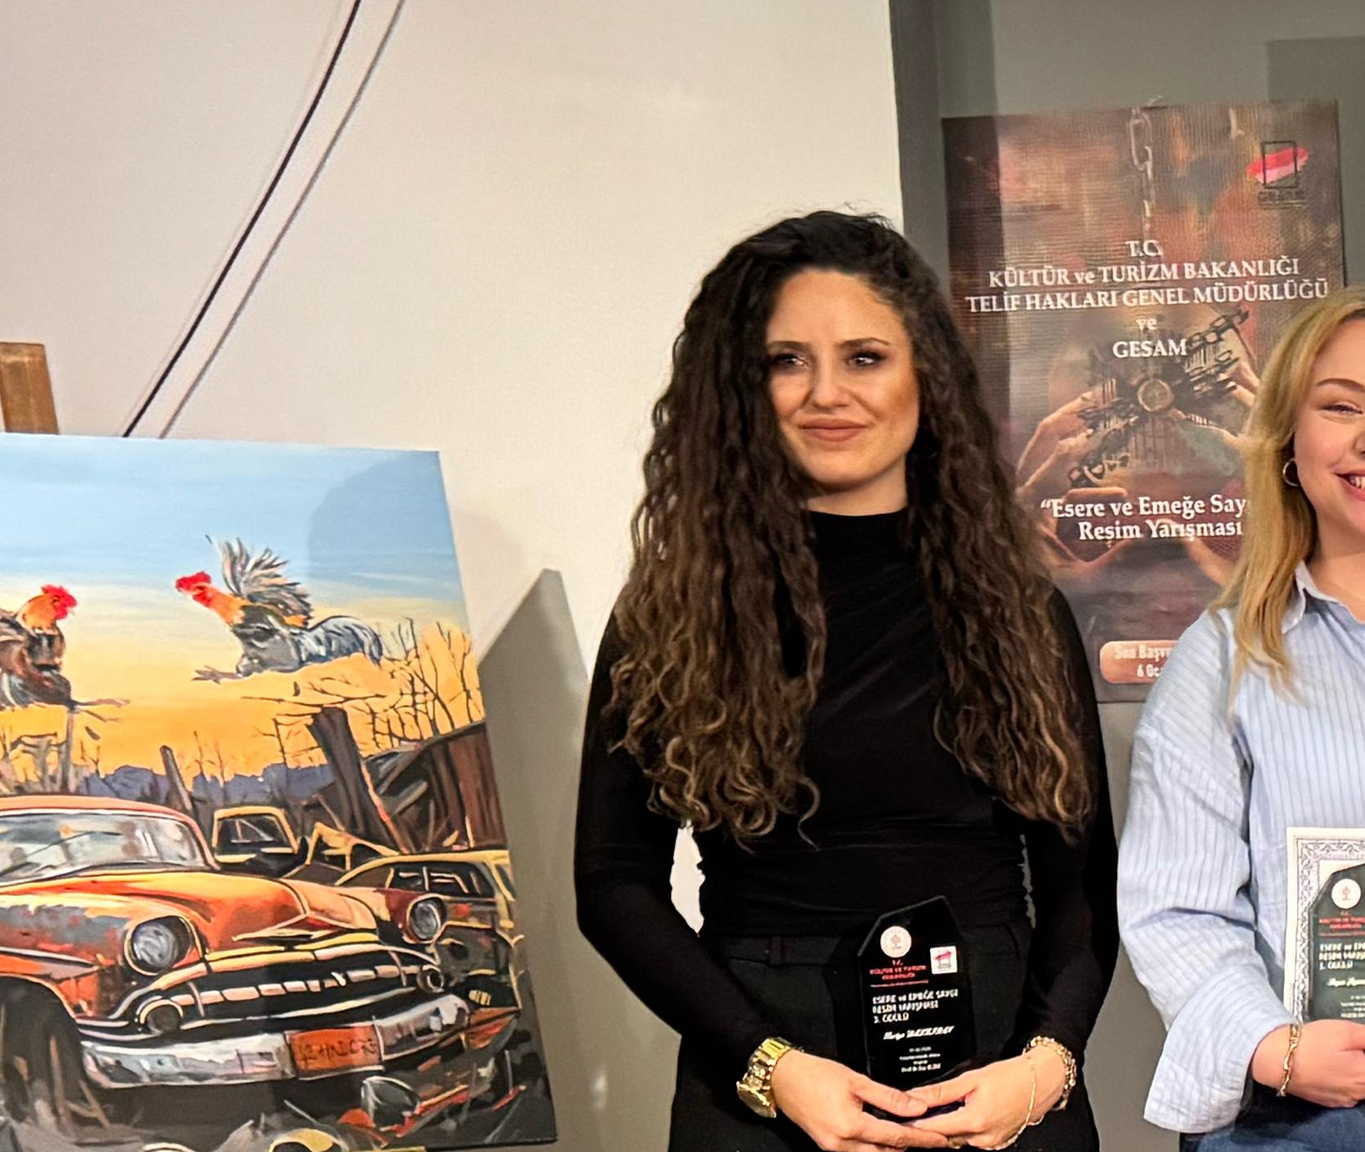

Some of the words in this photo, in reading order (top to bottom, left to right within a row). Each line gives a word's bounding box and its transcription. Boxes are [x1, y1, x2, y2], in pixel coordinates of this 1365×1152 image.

[988, 265, 1074, 288] KÜLTÜR
[1074, 272, 1096, 284] ve
[1098, 260, 1178, 283] TURİZM
[1184, 255, 1299, 280] BAKANLIĞI
[965, 291, 1020, 313] TELİF
[1025, 290, 1118, 311] HAKLARI
[1122, 287, 1189, 307] GENEL
[1193, 278, 1329, 304] MÜDÜRLÜĞÜ
[1136, 317, 1157, 331] ve
[1112, 339, 1188, 359] GESAM
[1110, 502, 1133, 516] ve
[1138, 496, 1206, 519] Emeğe
[1210, 494, 1246, 518] Say
[1078, 520, 1142, 540] Resim
[1146, 519, 1243, 542] Yarışması
[1146, 664, 1161, 677] Oc
